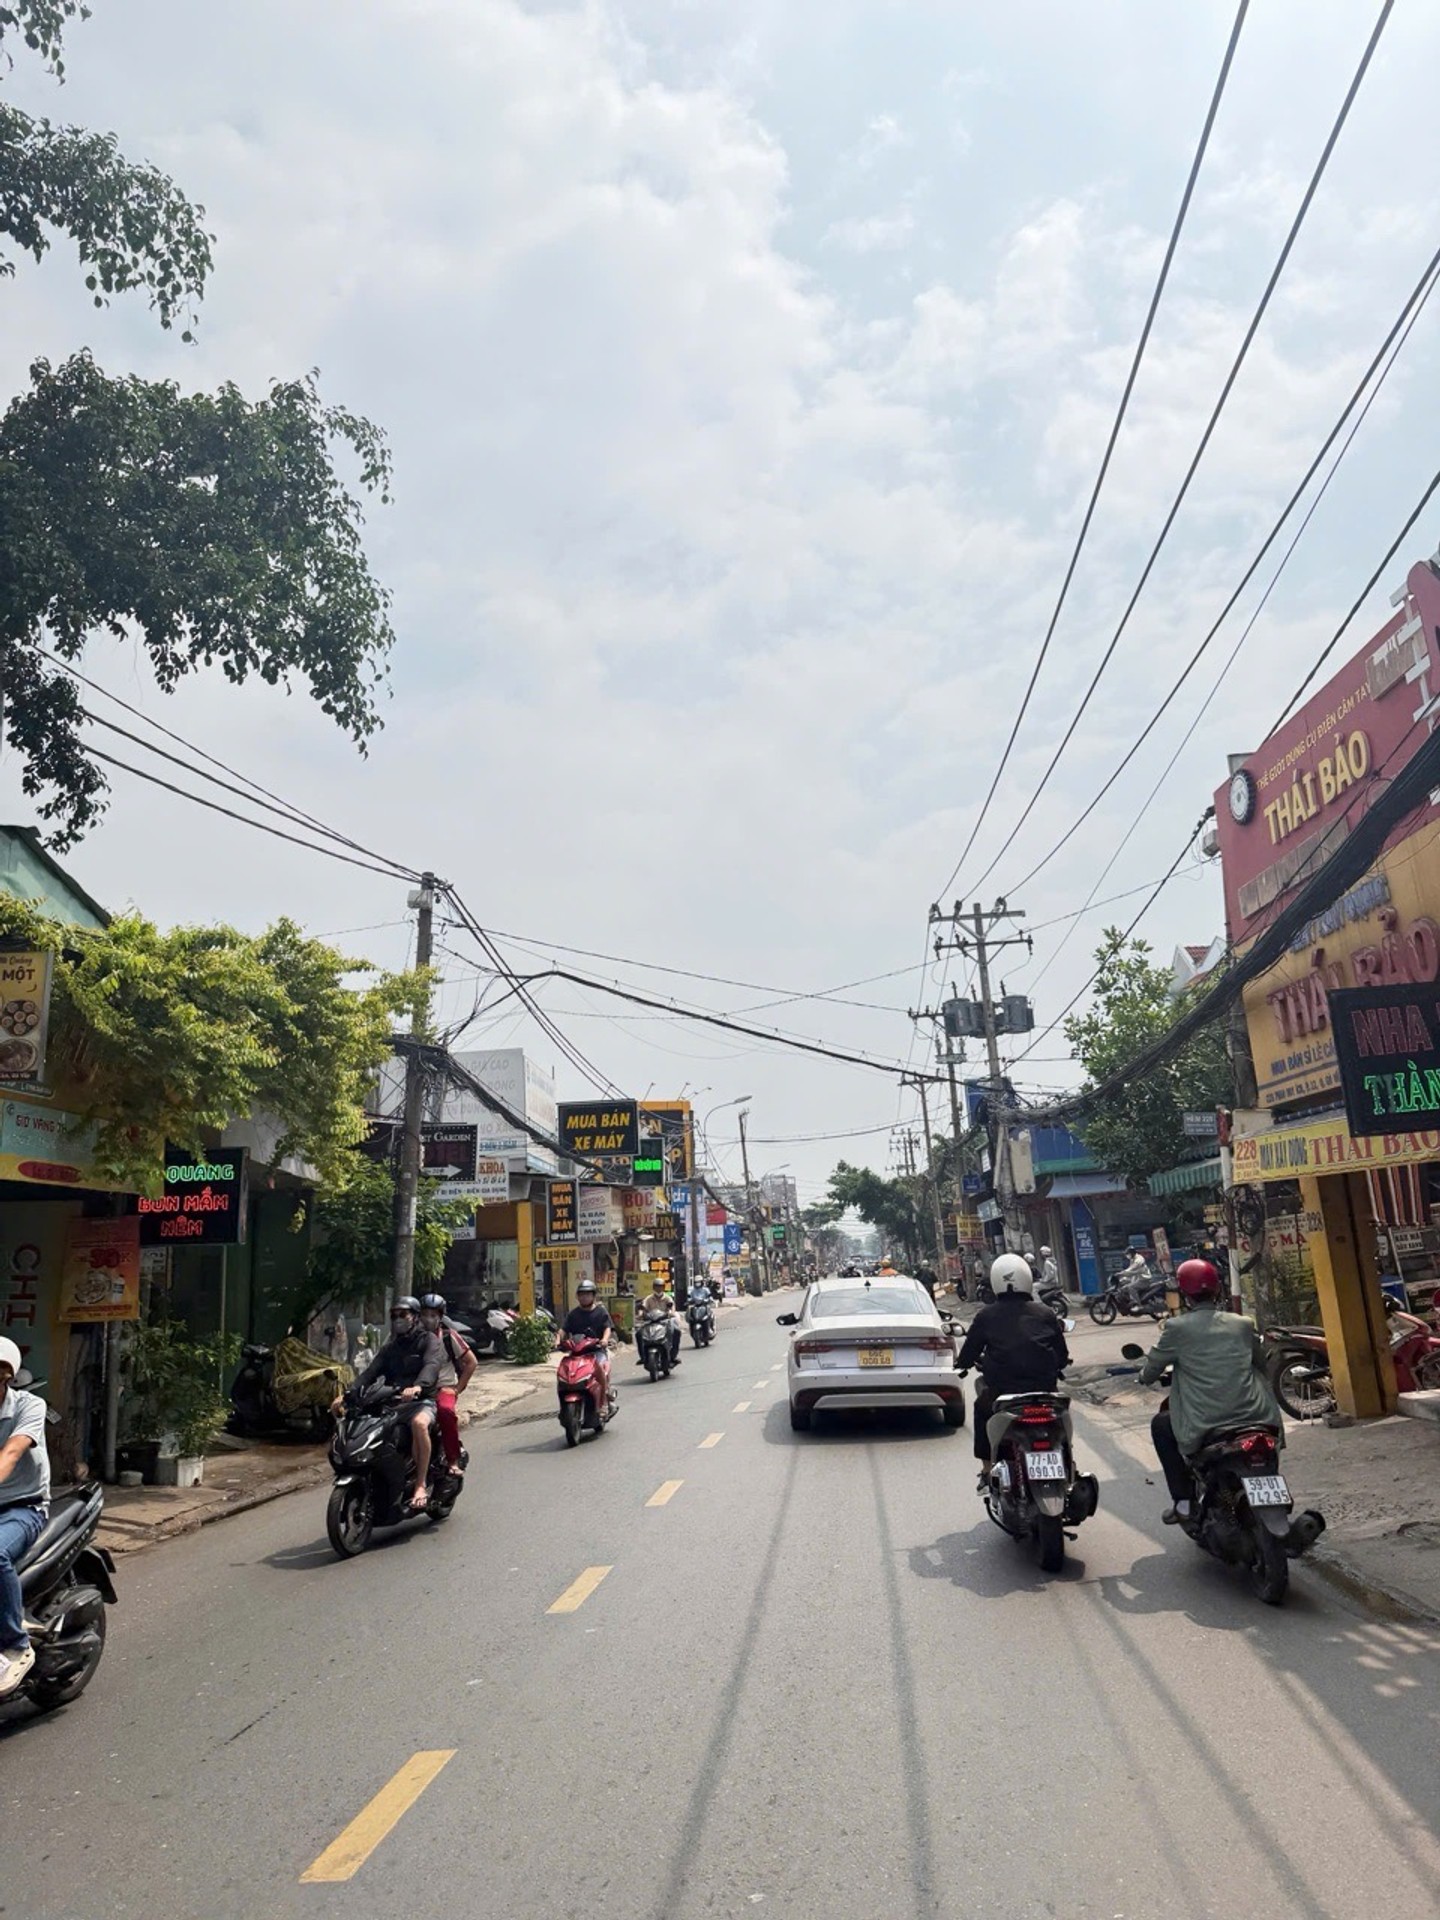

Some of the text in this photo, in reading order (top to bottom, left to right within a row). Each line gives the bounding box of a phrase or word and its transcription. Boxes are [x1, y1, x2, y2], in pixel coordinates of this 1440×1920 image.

[1263, 730, 1371, 846] THÁI BẢO
[566, 1114, 597, 1130] MUA
[600, 1109, 630, 1129] BÁN
[574, 1131, 625, 1150] XE MÁY
[1236, 1140, 1257, 1161] 228
[479, 1162, 505, 1174] KHOA
